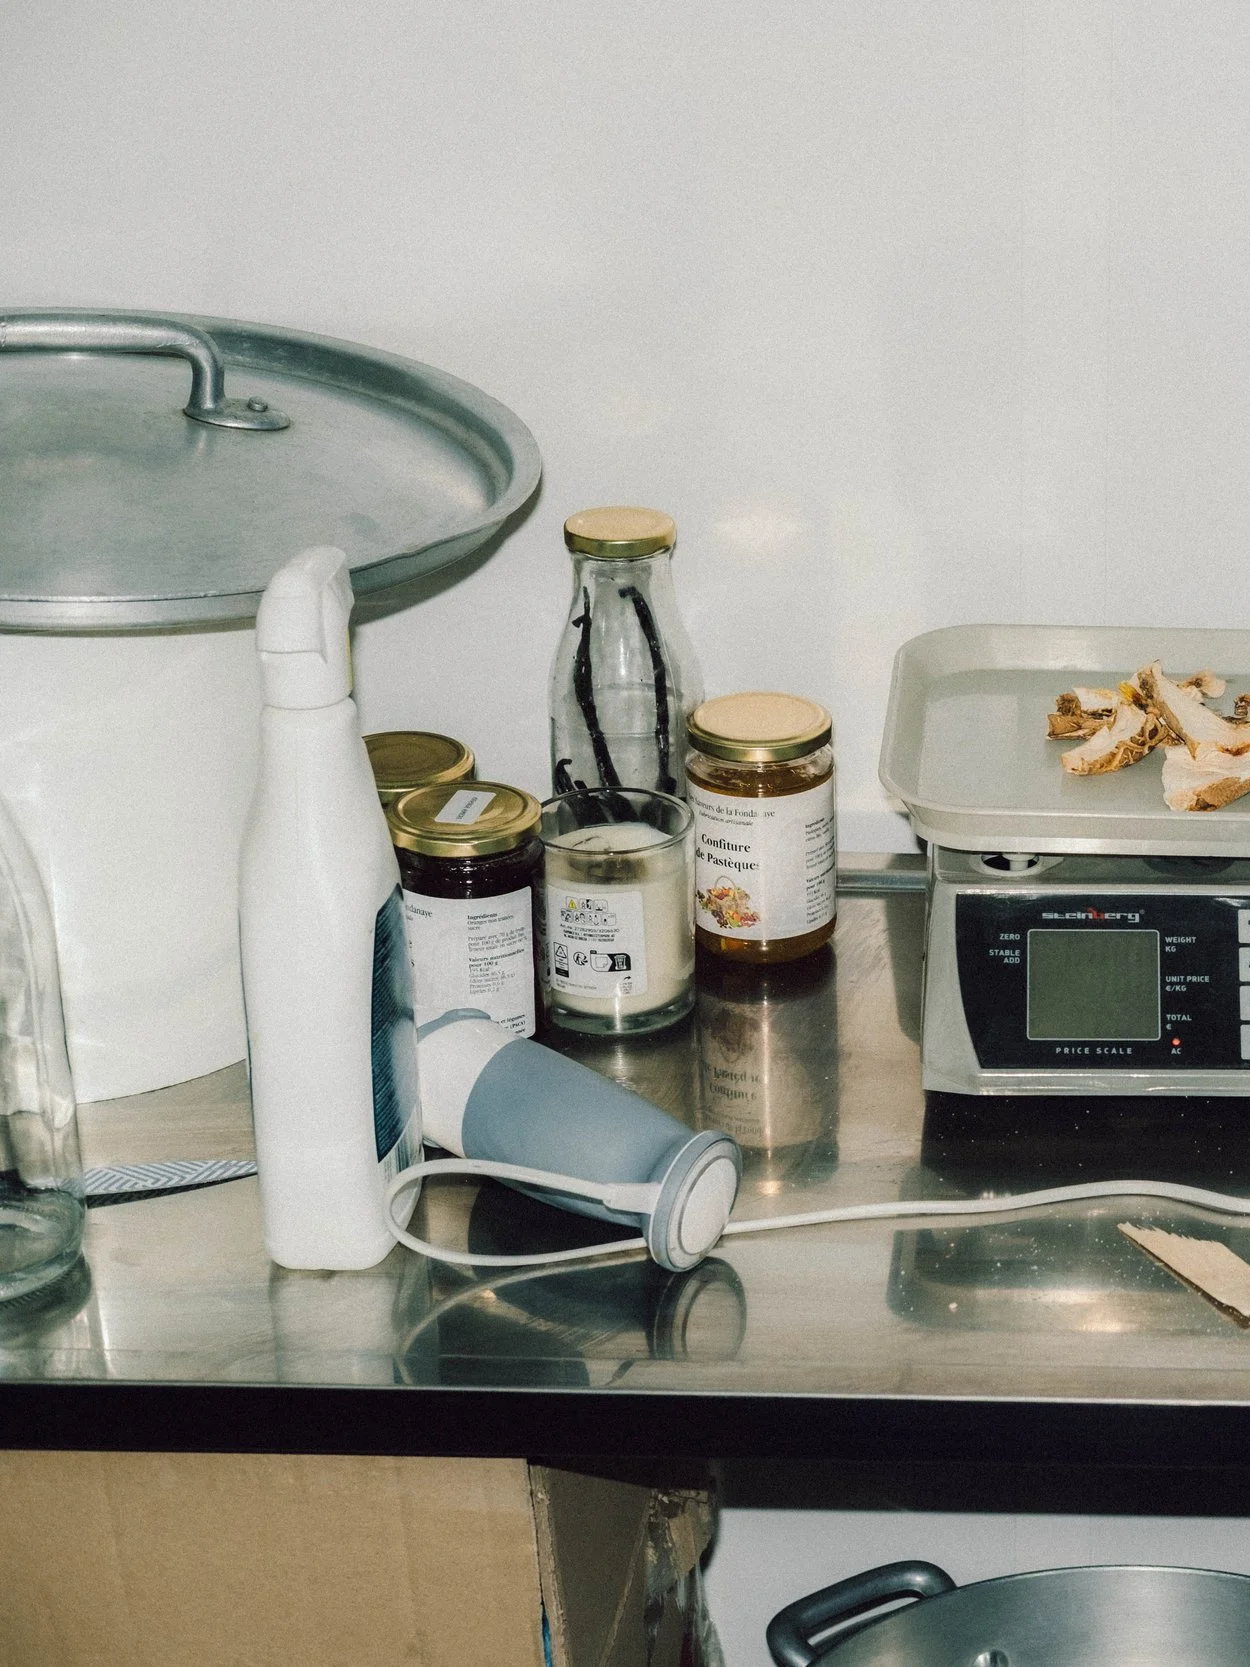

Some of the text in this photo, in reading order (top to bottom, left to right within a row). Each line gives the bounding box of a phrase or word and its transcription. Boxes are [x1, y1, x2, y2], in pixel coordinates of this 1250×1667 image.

[715, 804, 725, 814] de
[725, 806, 733, 816] la
[734, 807, 776, 818] Fondaaye
[701, 833, 751, 853] Confiture
[695, 846, 760, 873] de Pastèques
[999, 933, 1021, 941] ZERO
[1164, 936, 1197, 944] WEIGHT
[988, 949, 1021, 957] STABLE
[1165, 945, 1177, 953] KG
[1165, 975, 1210, 983] UNIT PRICE
[1165, 984, 1187, 992] €/KG
[1165, 1013, 1193, 1022] TOTAL
[1055, 1047, 1133, 1055] PRICE SCALE
[1170, 1047, 1182, 1055] AC
